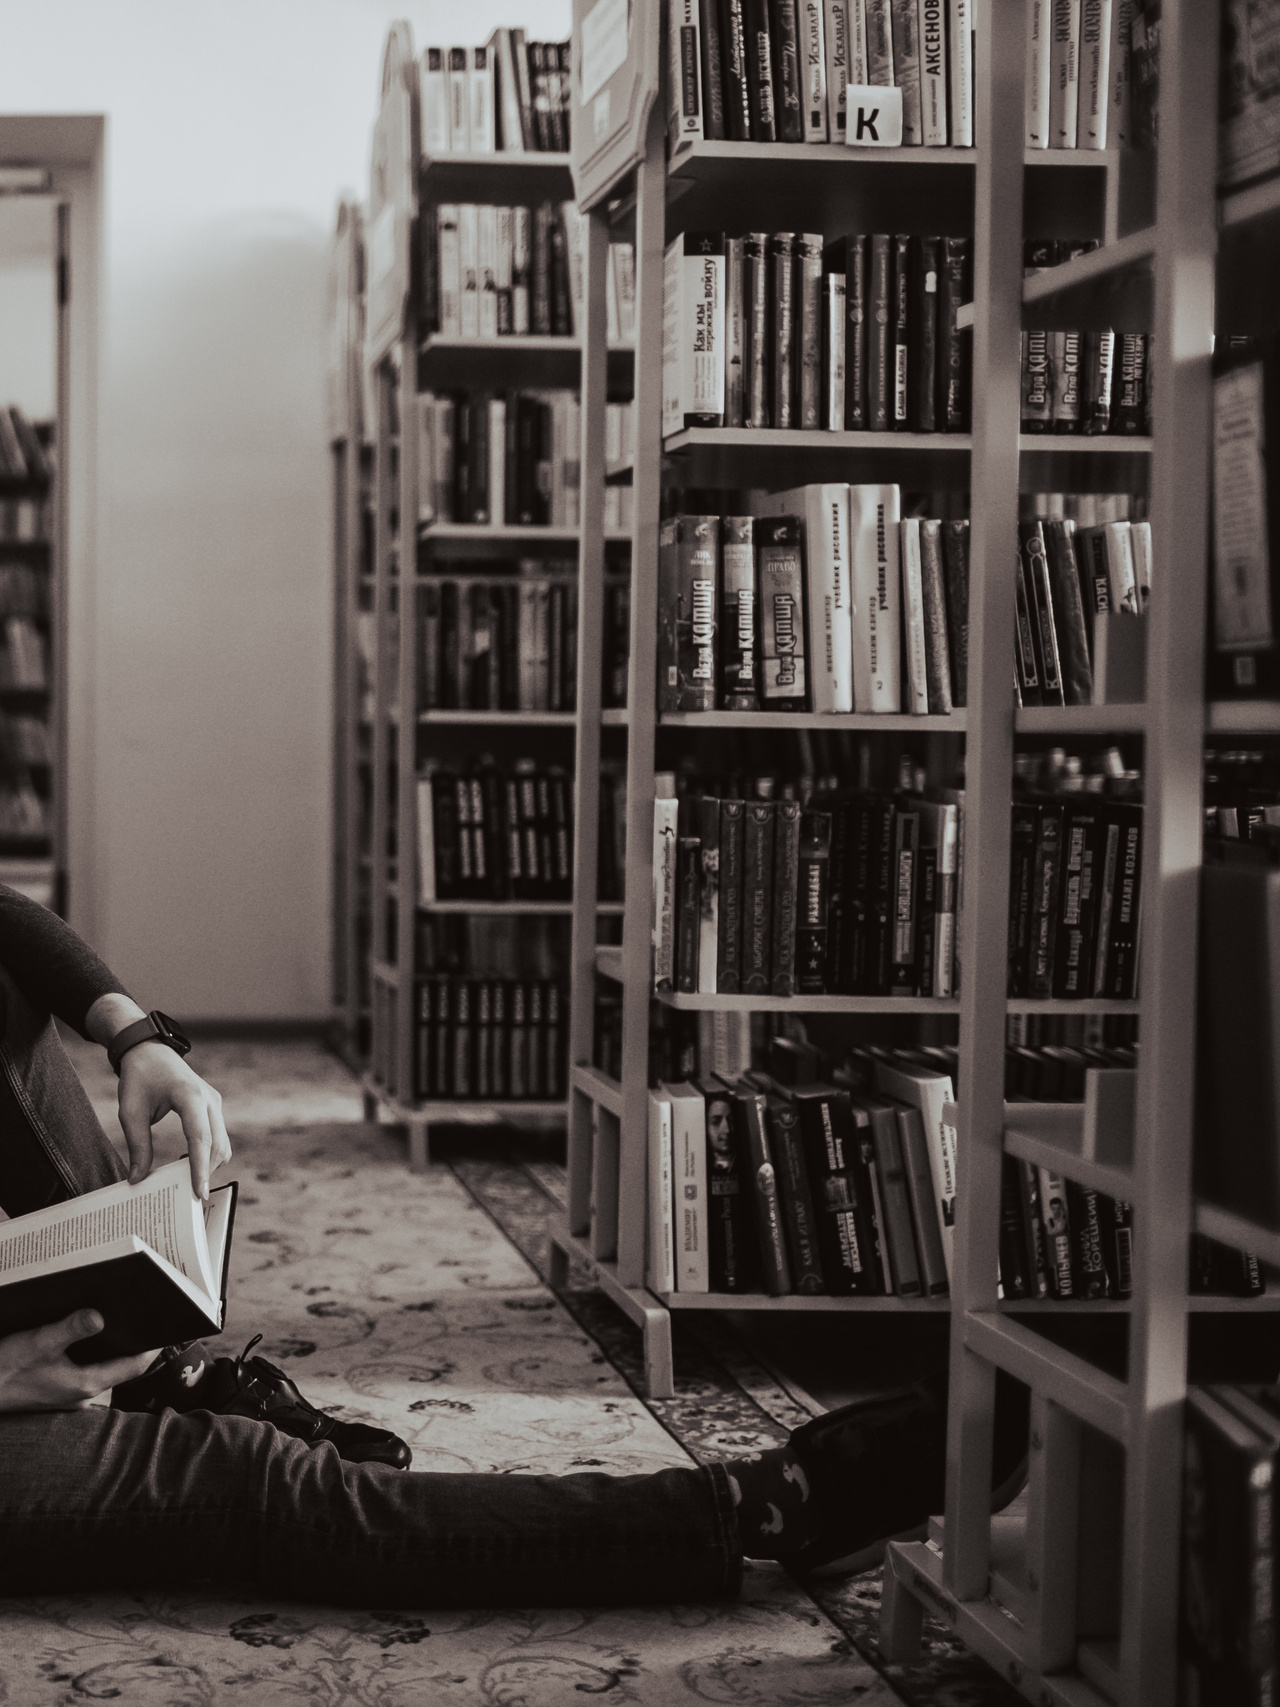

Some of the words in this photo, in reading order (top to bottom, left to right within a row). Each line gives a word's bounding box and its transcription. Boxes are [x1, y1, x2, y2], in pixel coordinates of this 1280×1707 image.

[807, 3, 820, 66] Искандер
[832, 5, 846, 68] Искандер
[924, 0, 941, 76] АКСЕНОВ
[855, 107, 881, 141] К
[700, 258, 717, 298] войну
[692, 328, 706, 353] Как
[696, 303, 706, 325] мы
[705, 301, 715, 352] пережили
[692, 578, 715, 645] КАМША
[738, 588, 755, 648] КАМША
[775, 593, 797, 653] КАМША
[1054, 1235, 1073, 1297] КОЛЫЧЕВ
